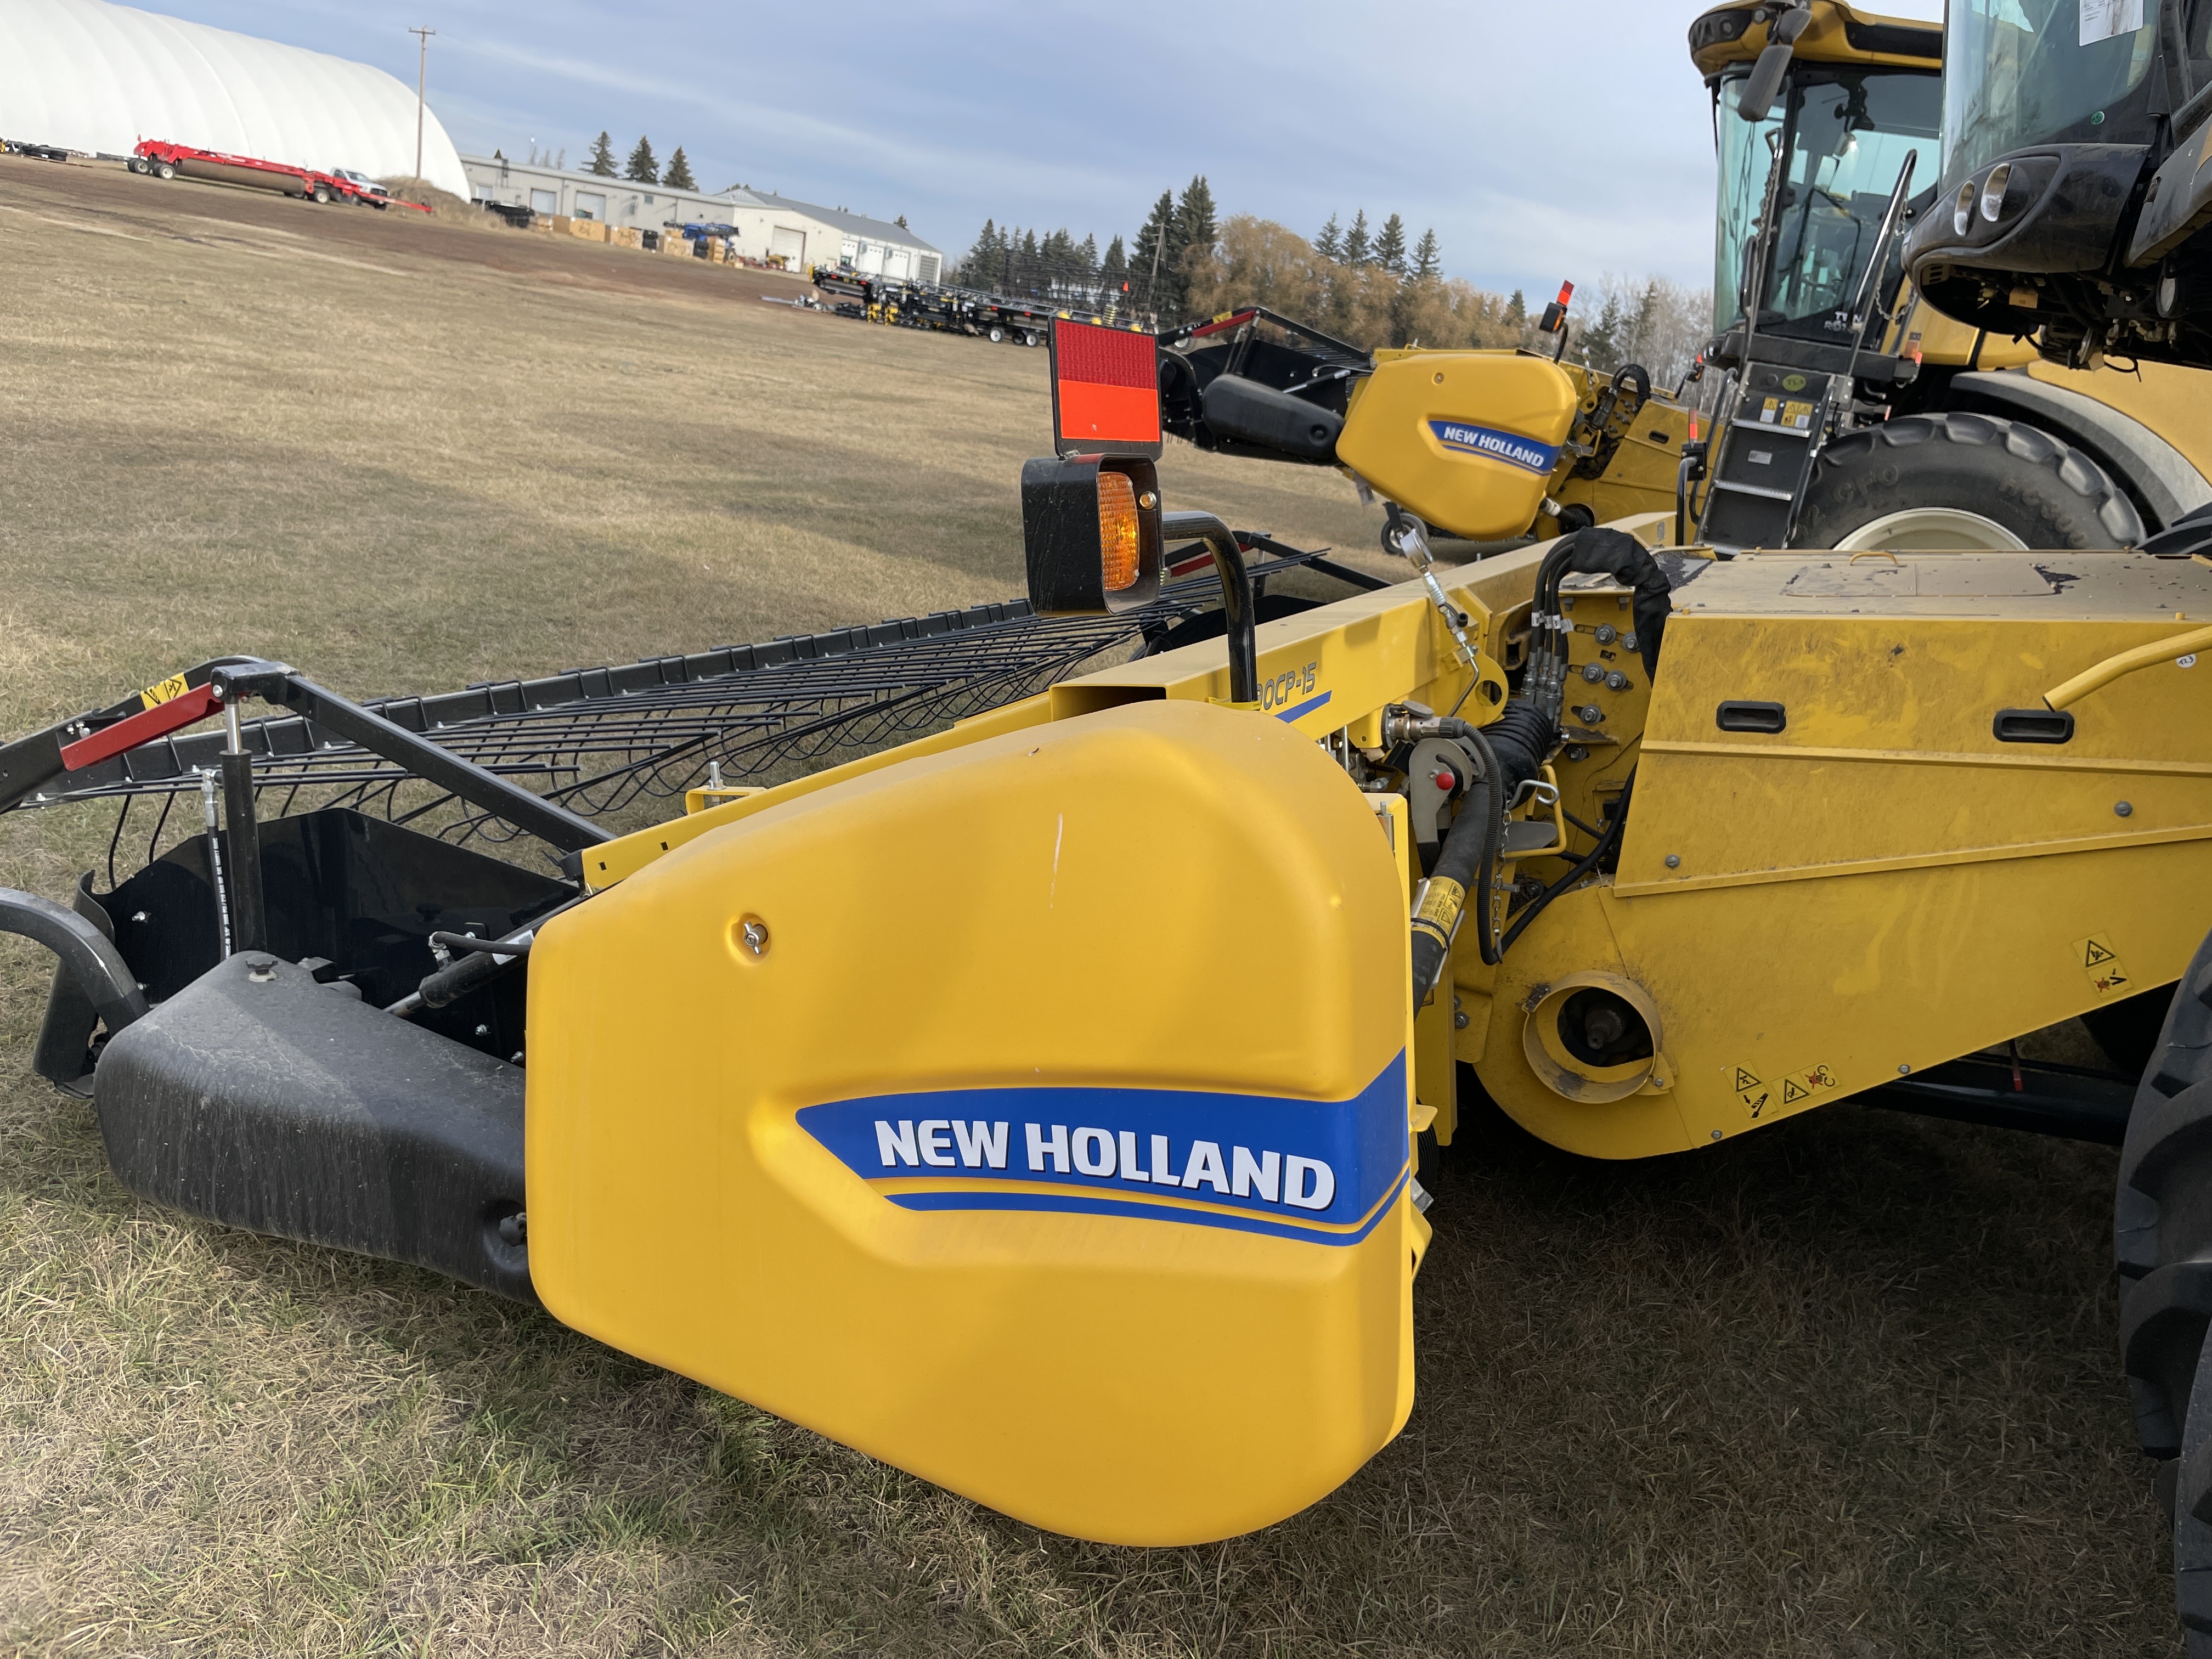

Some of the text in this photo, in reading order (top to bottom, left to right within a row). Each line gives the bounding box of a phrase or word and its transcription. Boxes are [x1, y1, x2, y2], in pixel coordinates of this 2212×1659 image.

[1443, 426, 1544, 467] NEW HOLLAND
[874, 1120, 1336, 1210] NEW HOLLAND
